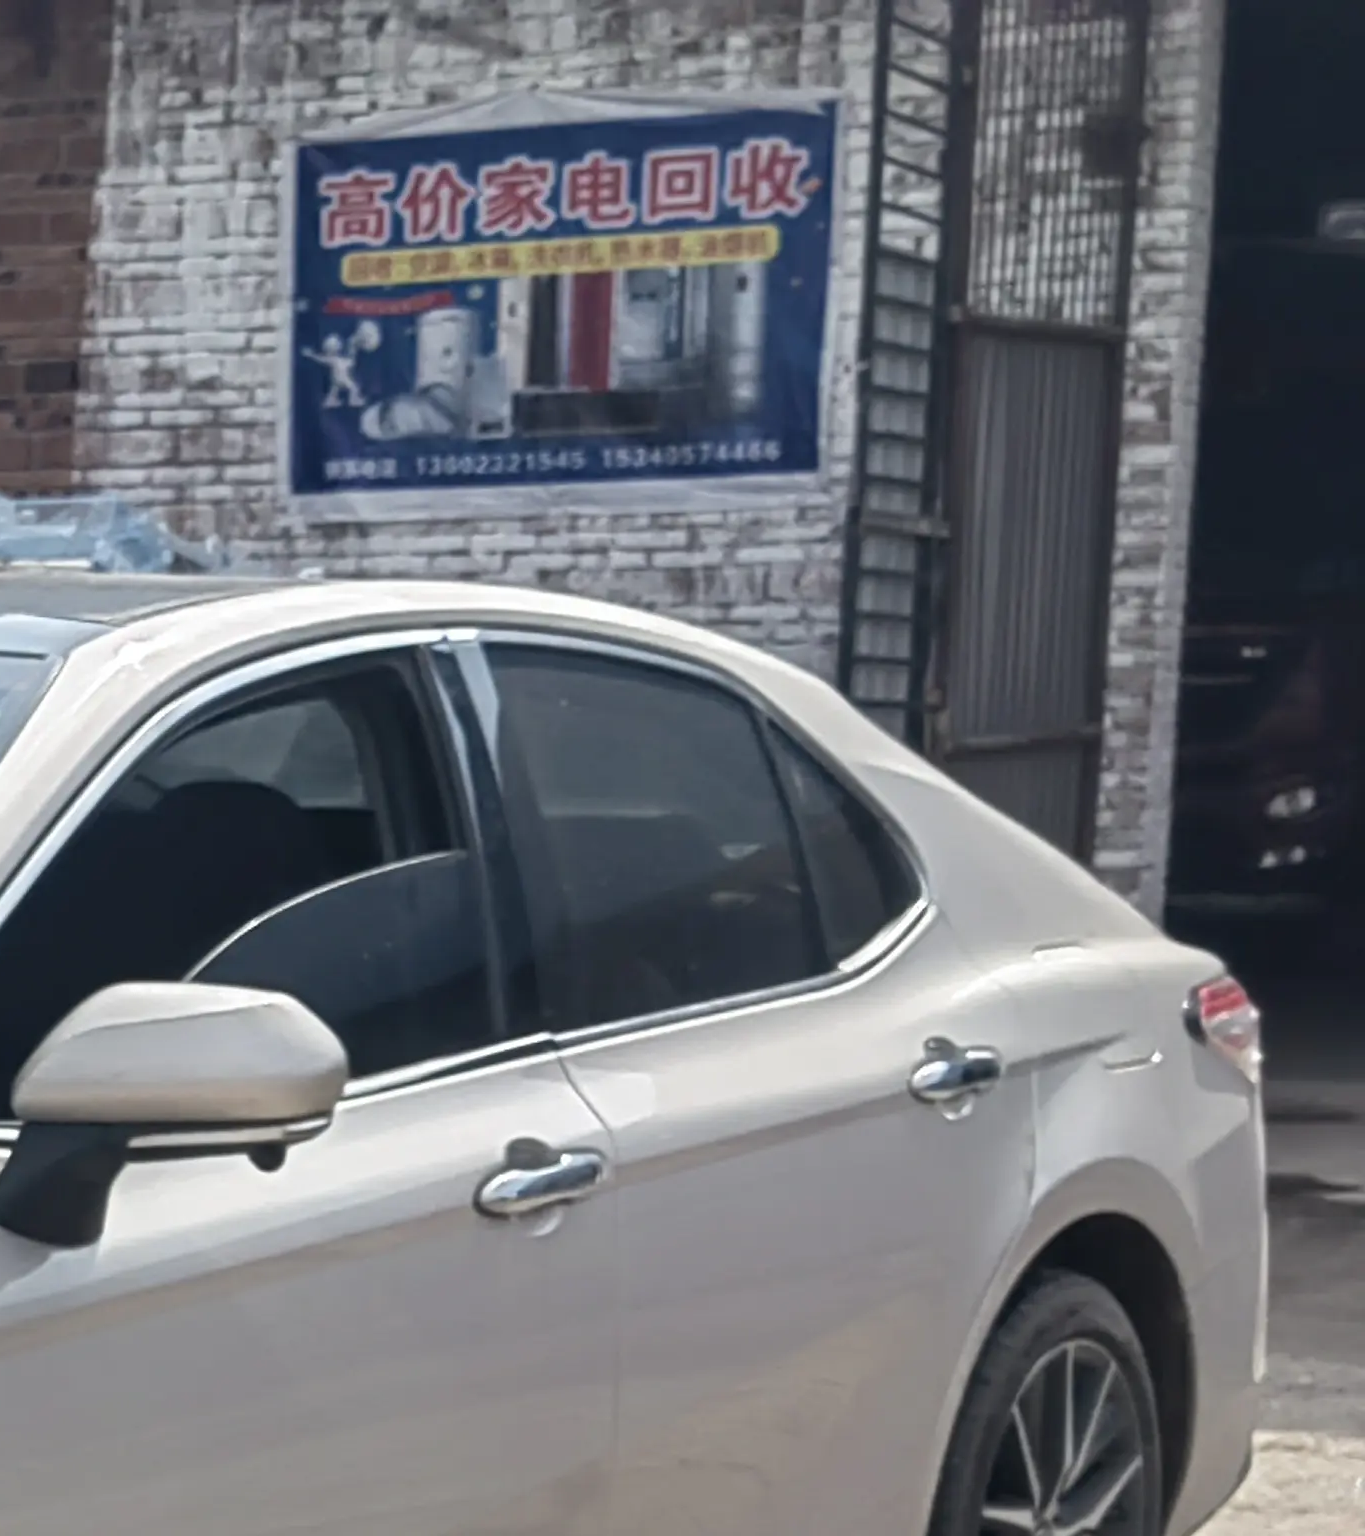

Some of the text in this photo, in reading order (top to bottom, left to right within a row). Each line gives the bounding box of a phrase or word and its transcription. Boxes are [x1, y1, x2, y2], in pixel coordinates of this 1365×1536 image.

[318, 138, 808, 247] 高价家电回收
